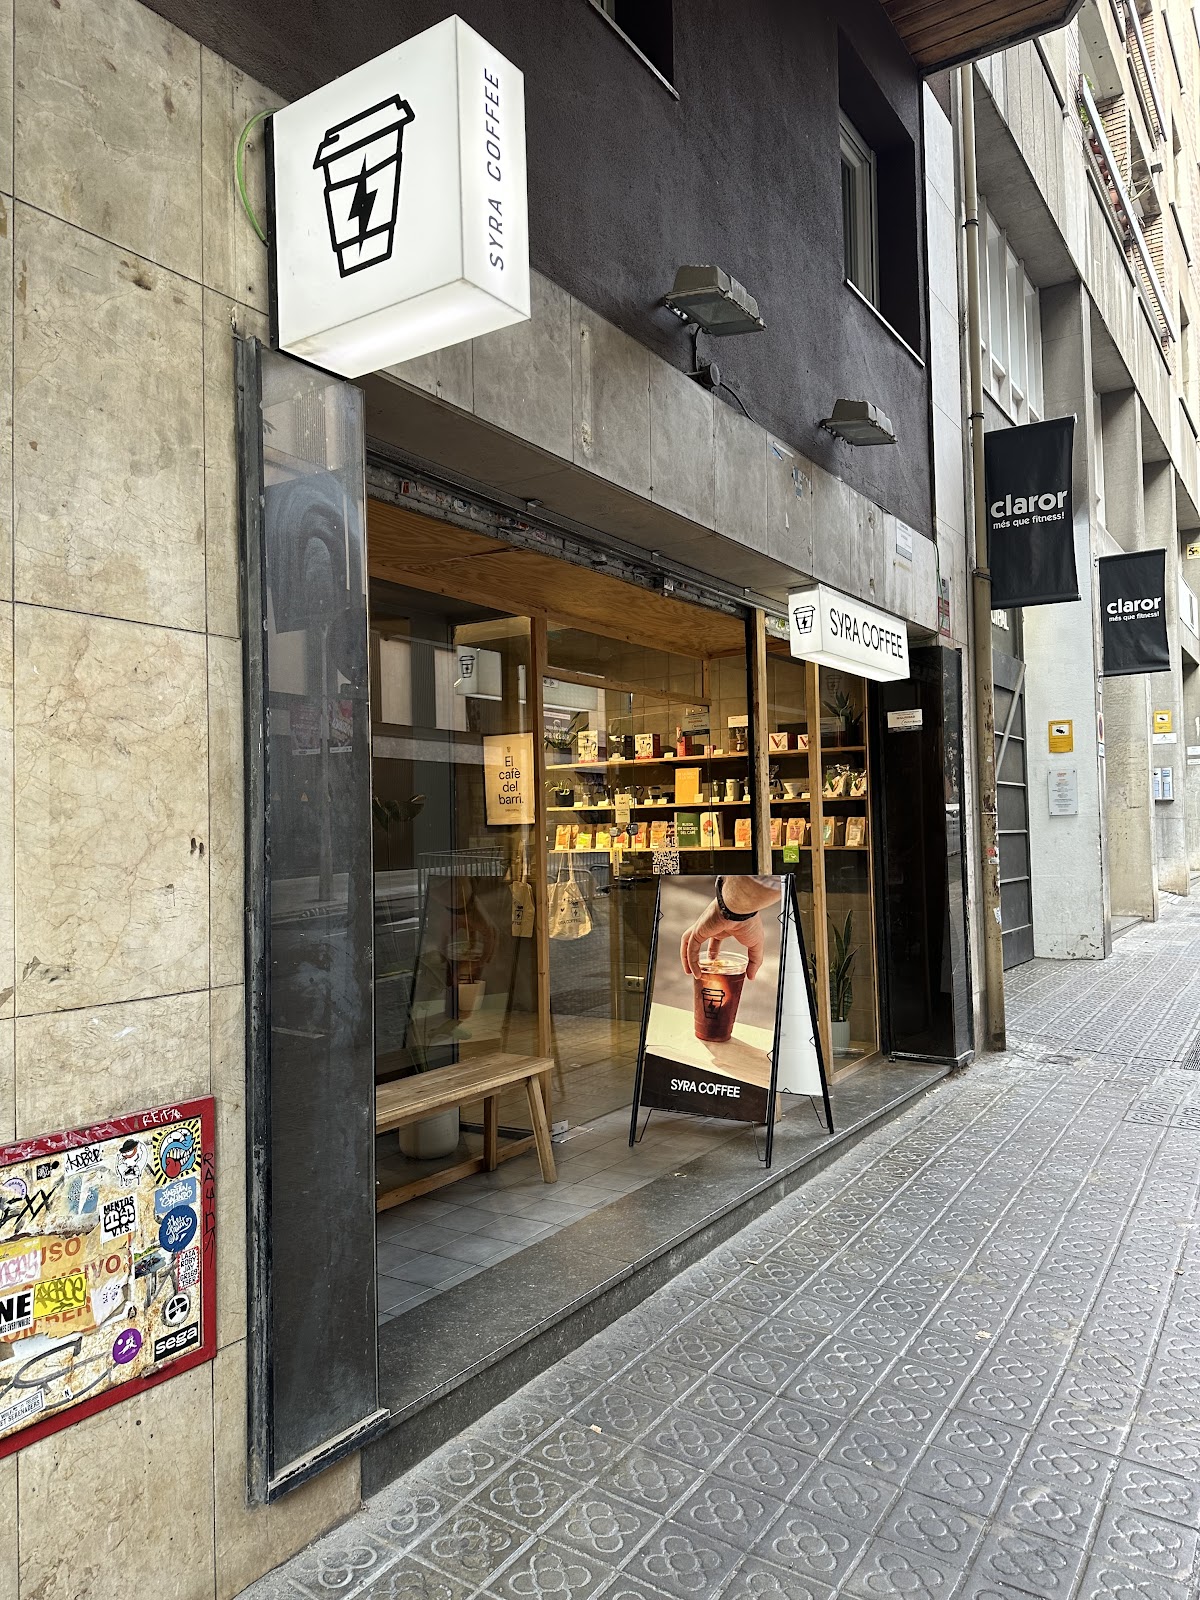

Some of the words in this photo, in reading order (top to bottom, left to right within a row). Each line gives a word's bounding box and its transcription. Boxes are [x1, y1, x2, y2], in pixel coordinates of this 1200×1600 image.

[485, 68, 501, 182] COFFEE
[489, 198, 504, 271] SYRA
[990, 490, 1067, 518] claror
[993, 520, 1011, 530] més
[1012, 517, 1030, 528] que
[1032, 511, 1065, 523] fitness!
[1106, 597, 1162, 614] claror
[1123, 614, 1136, 622] que
[1136, 611, 1160, 619] fitness!
[830, 607, 861, 645] SYRA
[861, 621, 904, 659] COFFEE
[504, 755, 514, 767] El
[498, 767, 521, 780] cafè
[502, 780, 518, 792] del
[498, 792, 524, 805] barri.
[670, 1078, 697, 1092] SYRA
[698, 1082, 741, 1098] COFFEE
[155, 1326, 198, 1355] sega
